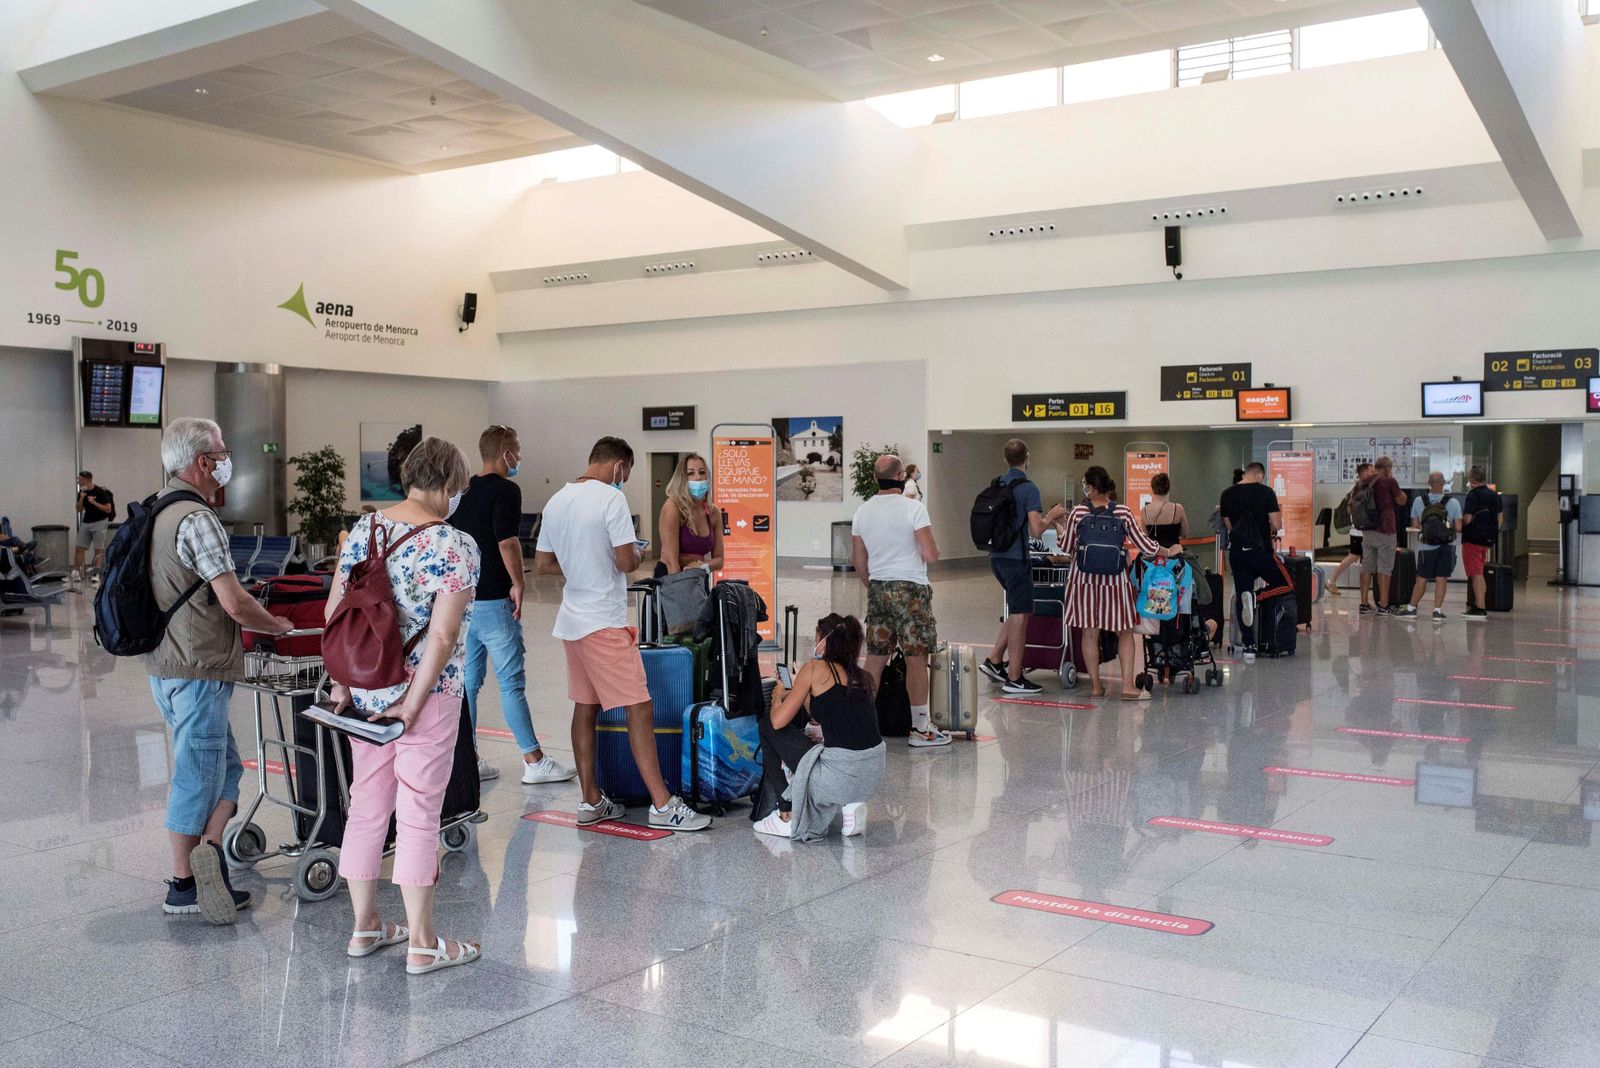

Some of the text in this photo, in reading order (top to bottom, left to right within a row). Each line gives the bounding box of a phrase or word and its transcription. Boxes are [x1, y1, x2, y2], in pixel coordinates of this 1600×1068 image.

[54, 249, 105, 308] 50
[315, 301, 354, 317] aena
[27, 312, 138, 333] 1969 2019
[325, 318, 419, 336] Aeropuerto de Menorca
[325, 329, 405, 346] Aeroport de Menorca
[1492, 358, 1592, 372] 02 03
[1232, 370, 1246, 381] 01
[1073, 404, 1111, 414] 01 16
[718, 449, 748, 459] ¿SOLO
[718, 458, 751, 467] LLEVAS
[718, 467, 760, 476] EQUIPAJE
[718, 476, 768, 486] DE MANO?
[1344, 775, 1401, 784] distance
[604, 806, 614, 815] N
[670, 814, 684, 826] N
[1158, 818, 1239, 832] Mantingueu
[1013, 895, 1189, 930] Mantén la distancia
